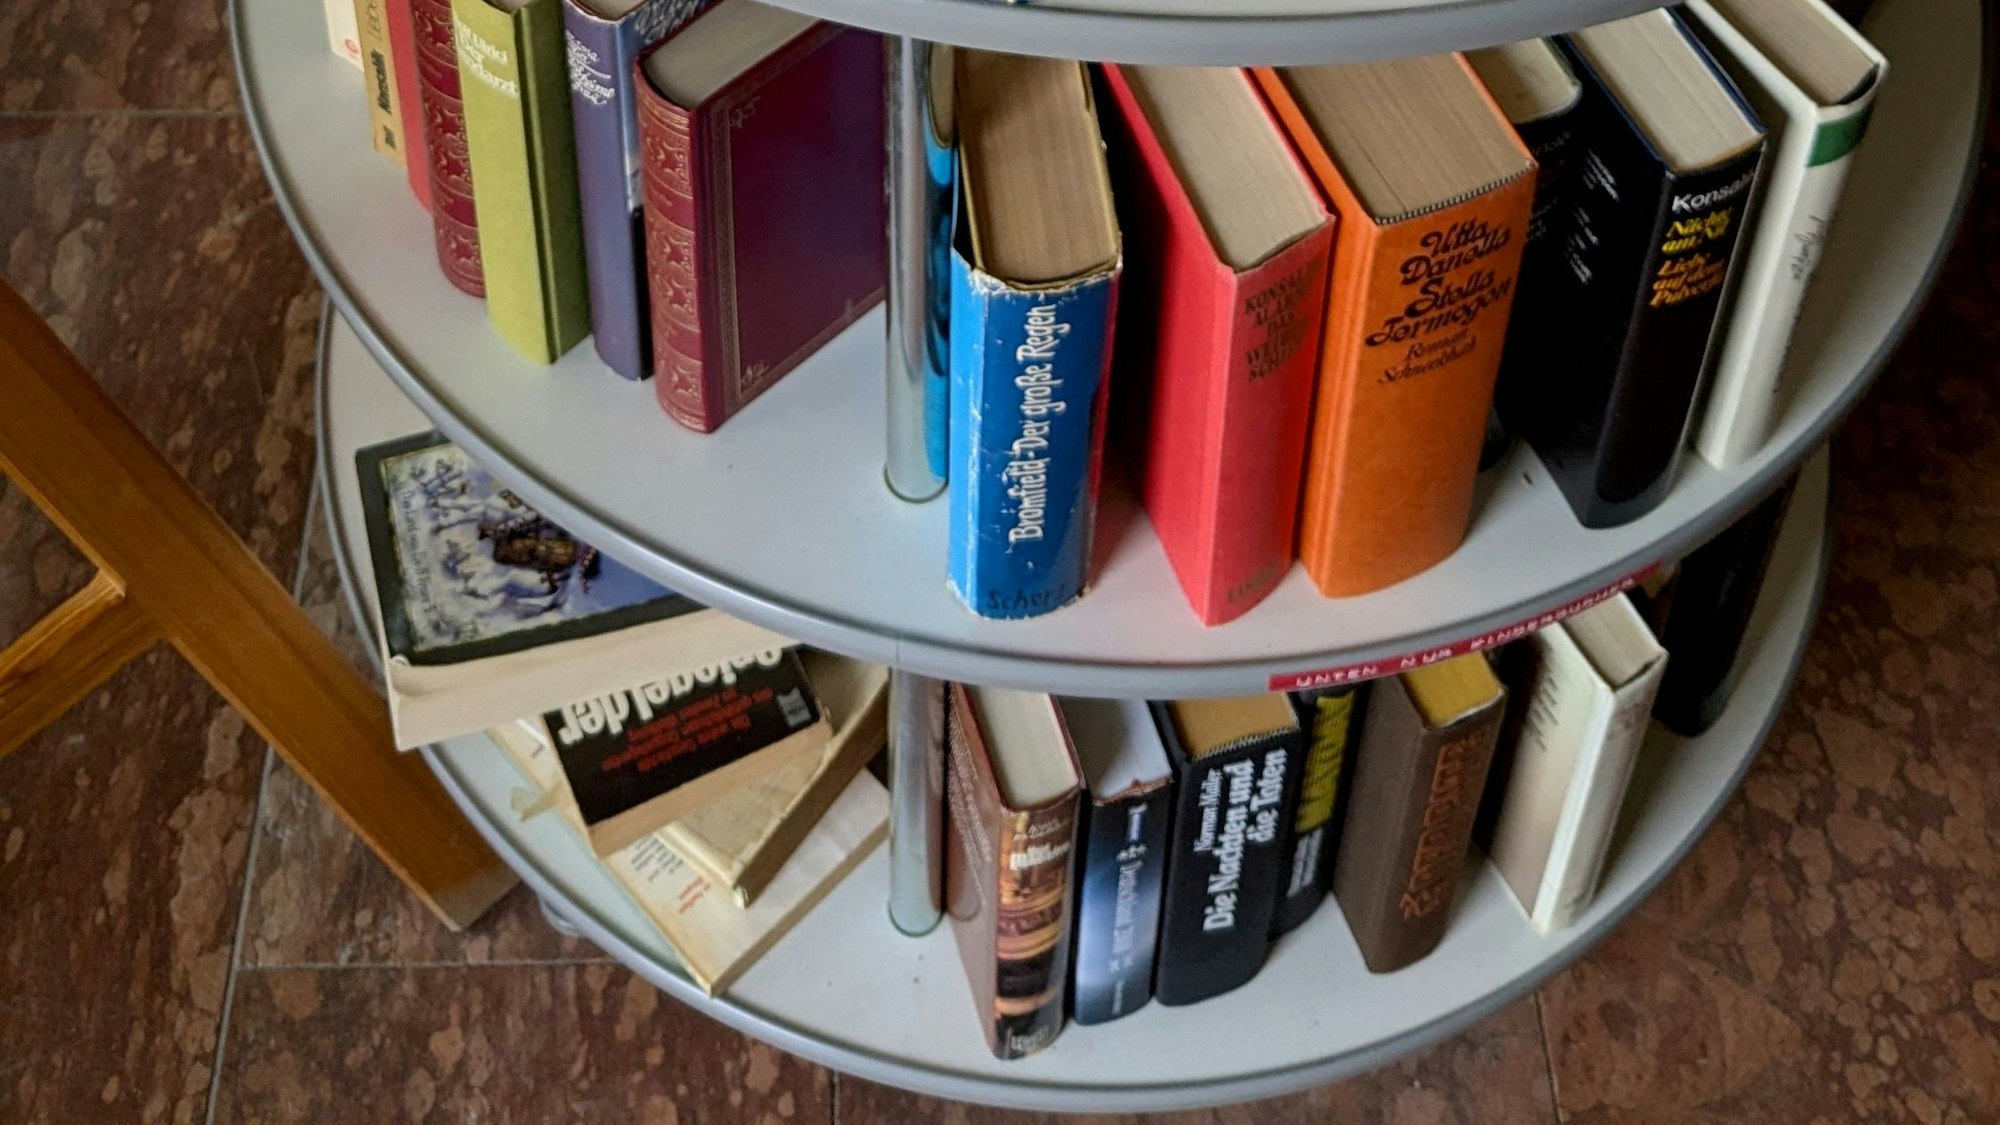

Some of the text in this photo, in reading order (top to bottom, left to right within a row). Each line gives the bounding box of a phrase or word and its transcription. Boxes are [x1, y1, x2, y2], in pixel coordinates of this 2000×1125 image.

[1671, 168, 1757, 214] Konsal
[1400, 226, 1512, 286] Danella
[1420, 216, 1490, 258] Utta
[1404, 269, 1496, 318] Stella
[1015, 303, 1071, 363] Regen
[1014, 362, 1067, 419] große
[1295, 665, 1378, 688] UNTEN
[1246, 747, 1288, 843] die Toten
[1203, 891, 1238, 932] Die
[1222, 758, 1256, 805] und
